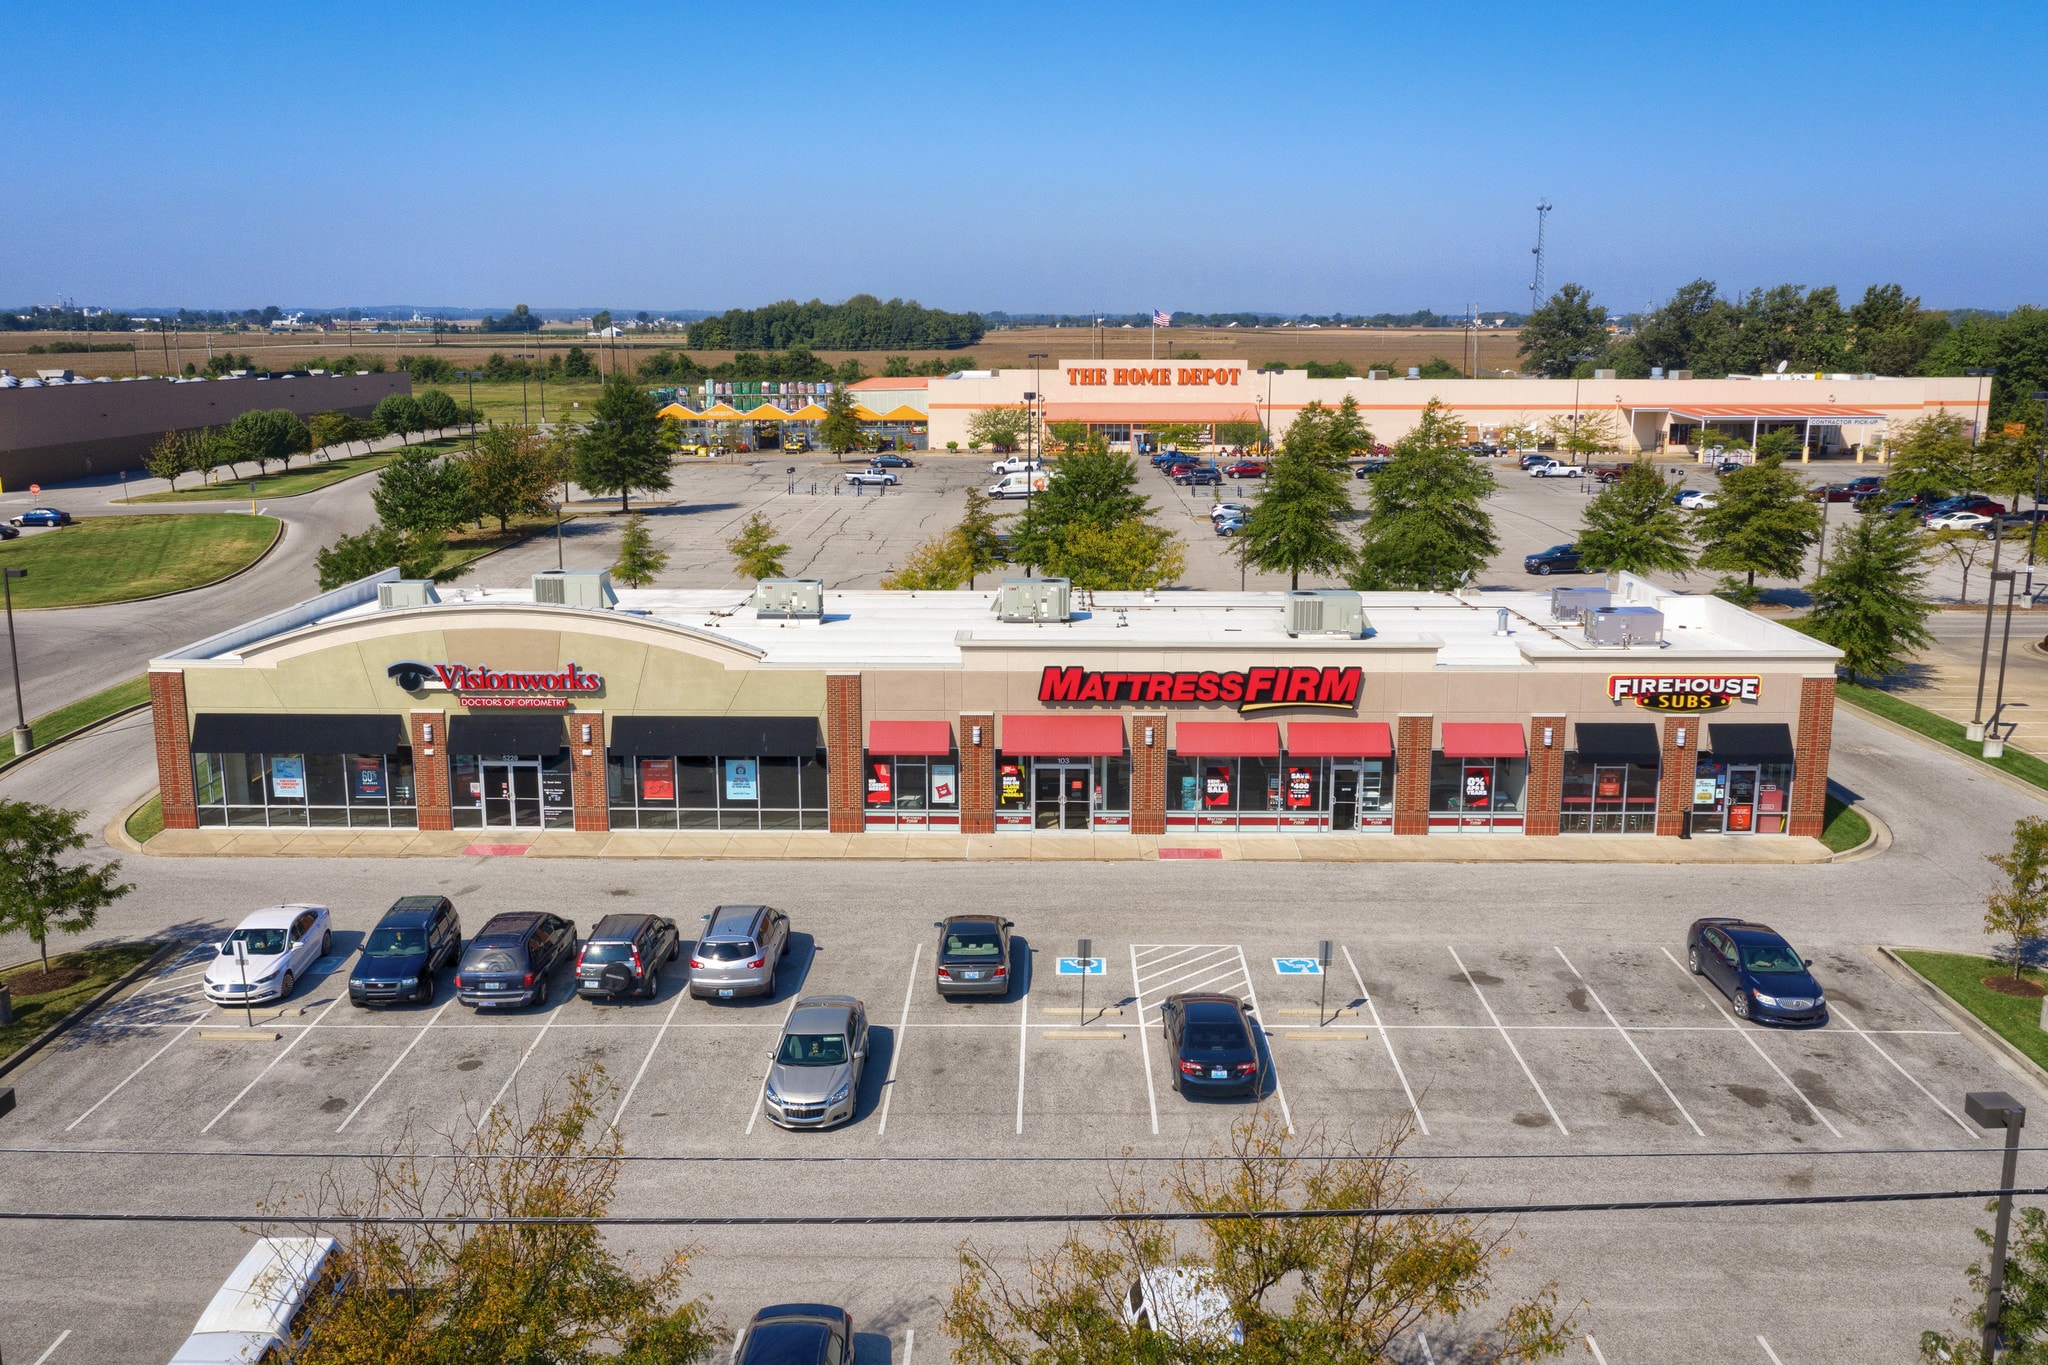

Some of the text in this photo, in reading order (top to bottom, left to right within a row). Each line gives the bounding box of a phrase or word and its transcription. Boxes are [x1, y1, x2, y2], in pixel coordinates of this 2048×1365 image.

[1067, 368, 1241, 385] THE HOME DEPOT
[434, 662, 600, 691] Visionworks
[1040, 668, 1362, 701] MATTRESS FIRM
[1614, 678, 1758, 700] FIREHOUSE
[461, 699, 566, 707] DOCTORS OF OPTOMETRY
[1658, 695, 1711, 708] SUBS
[1467, 777, 1485, 786] 0%
